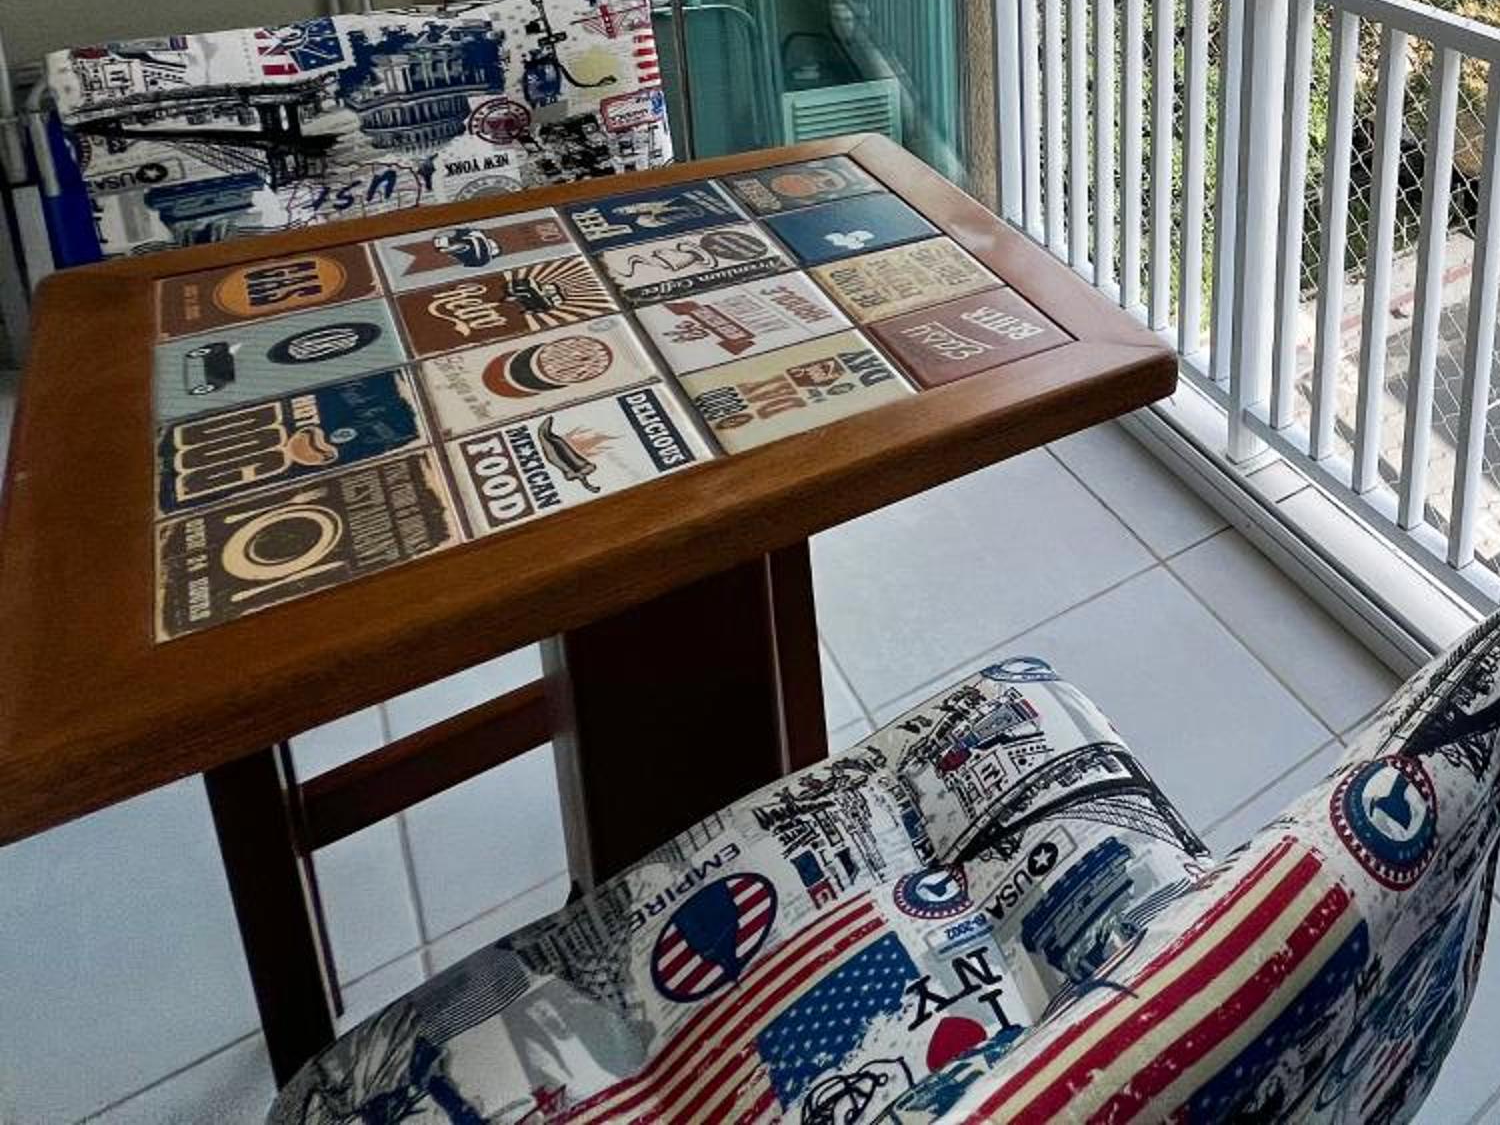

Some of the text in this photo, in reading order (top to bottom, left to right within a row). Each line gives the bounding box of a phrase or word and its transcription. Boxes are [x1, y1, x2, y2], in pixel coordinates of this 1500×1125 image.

[95, 172, 136, 190] USA
[445, 153, 510, 177] NEW YORK
[571, 208, 633, 242] BEER
[243, 260, 323, 308] GAS
[639, 259, 774, 298] Premium Coffee
[427, 283, 508, 337] Retro
[837, 349, 895, 387] DAY
[736, 375, 807, 420] DAY
[174, 401, 292, 502] DOG
[626, 389, 685, 465] DELICIOUS
[467, 435, 527, 519] FOOD
[505, 425, 563, 510] MEXICAN
[184, 517, 206, 552] OPEN
[340, 469, 400, 569] RESTAURANT
[187, 576, 210, 622] HOURS
[628, 842, 741, 934] EMPIRE
[985, 868, 1033, 921] USA
[905, 946, 1003, 1032] NY
